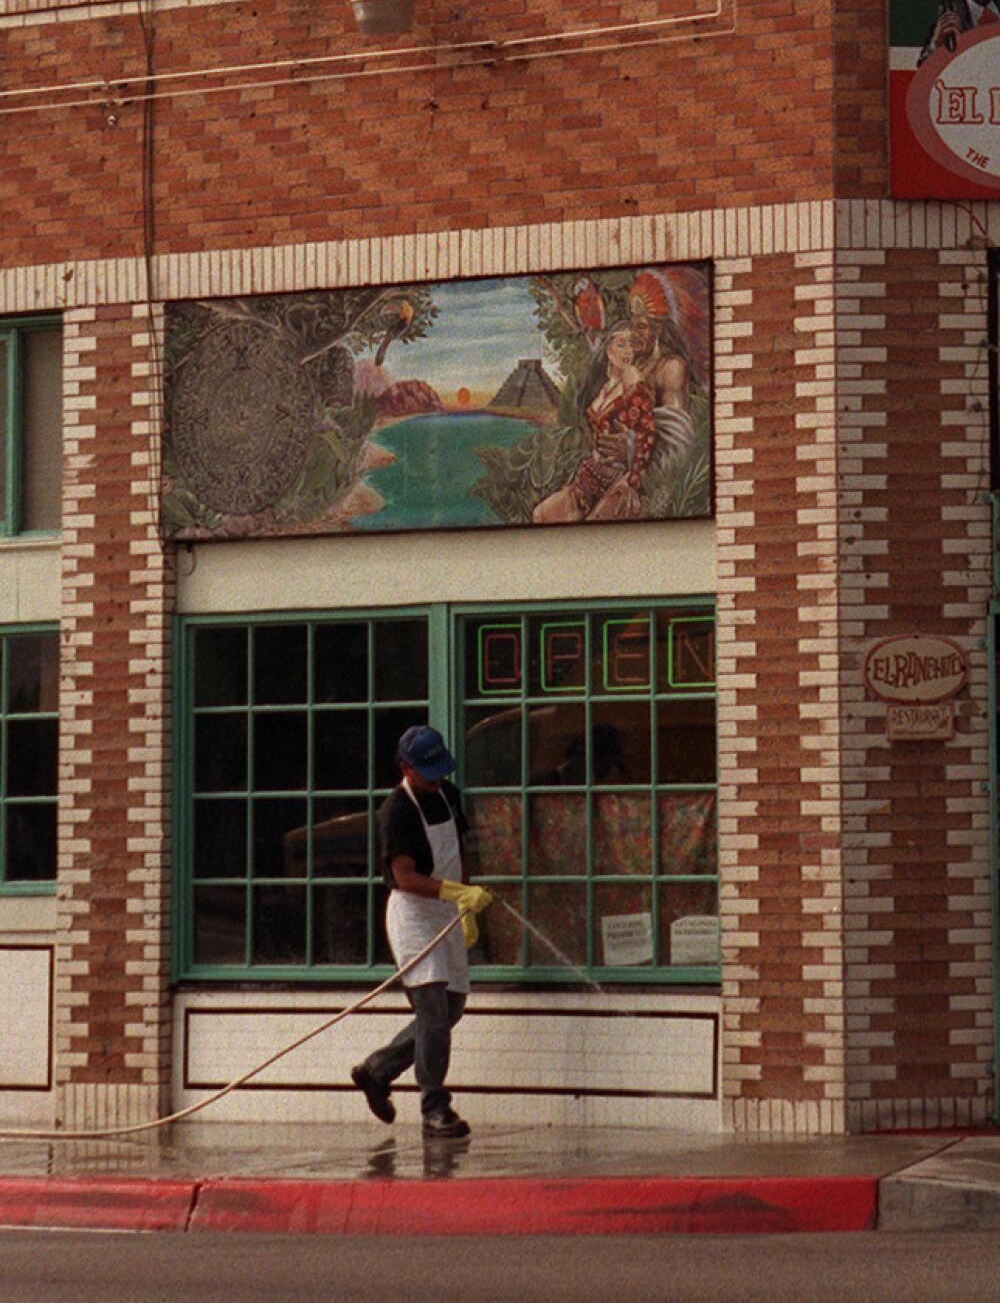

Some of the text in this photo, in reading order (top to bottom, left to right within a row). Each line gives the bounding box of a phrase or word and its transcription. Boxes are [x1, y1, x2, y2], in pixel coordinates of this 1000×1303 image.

[934, 78, 984, 126] EL
[964, 147, 990, 168] THE
[484, 631, 715, 684] OPEN
